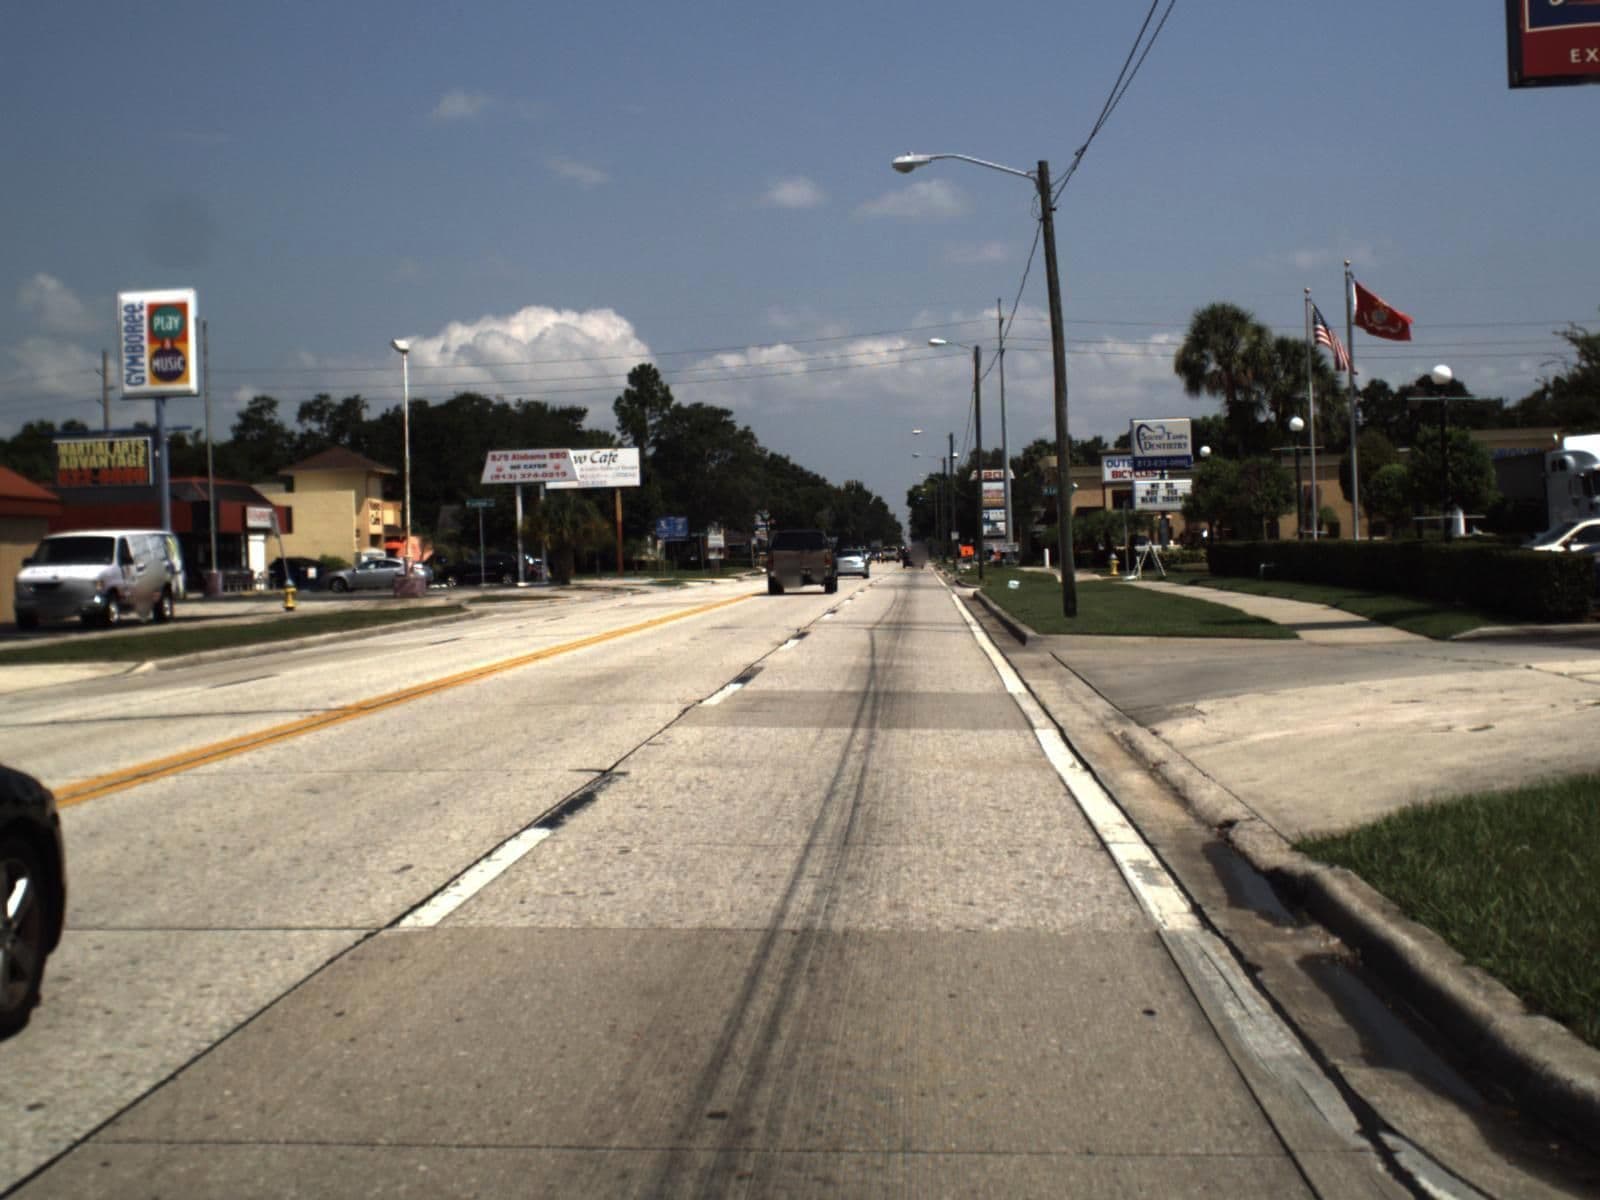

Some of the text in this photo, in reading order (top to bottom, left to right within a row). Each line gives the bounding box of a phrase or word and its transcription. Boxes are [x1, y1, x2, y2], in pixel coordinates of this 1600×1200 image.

[58, 439, 146, 457] MARTIAL ARTS
[58, 455, 146, 470] ADVANTAGE
